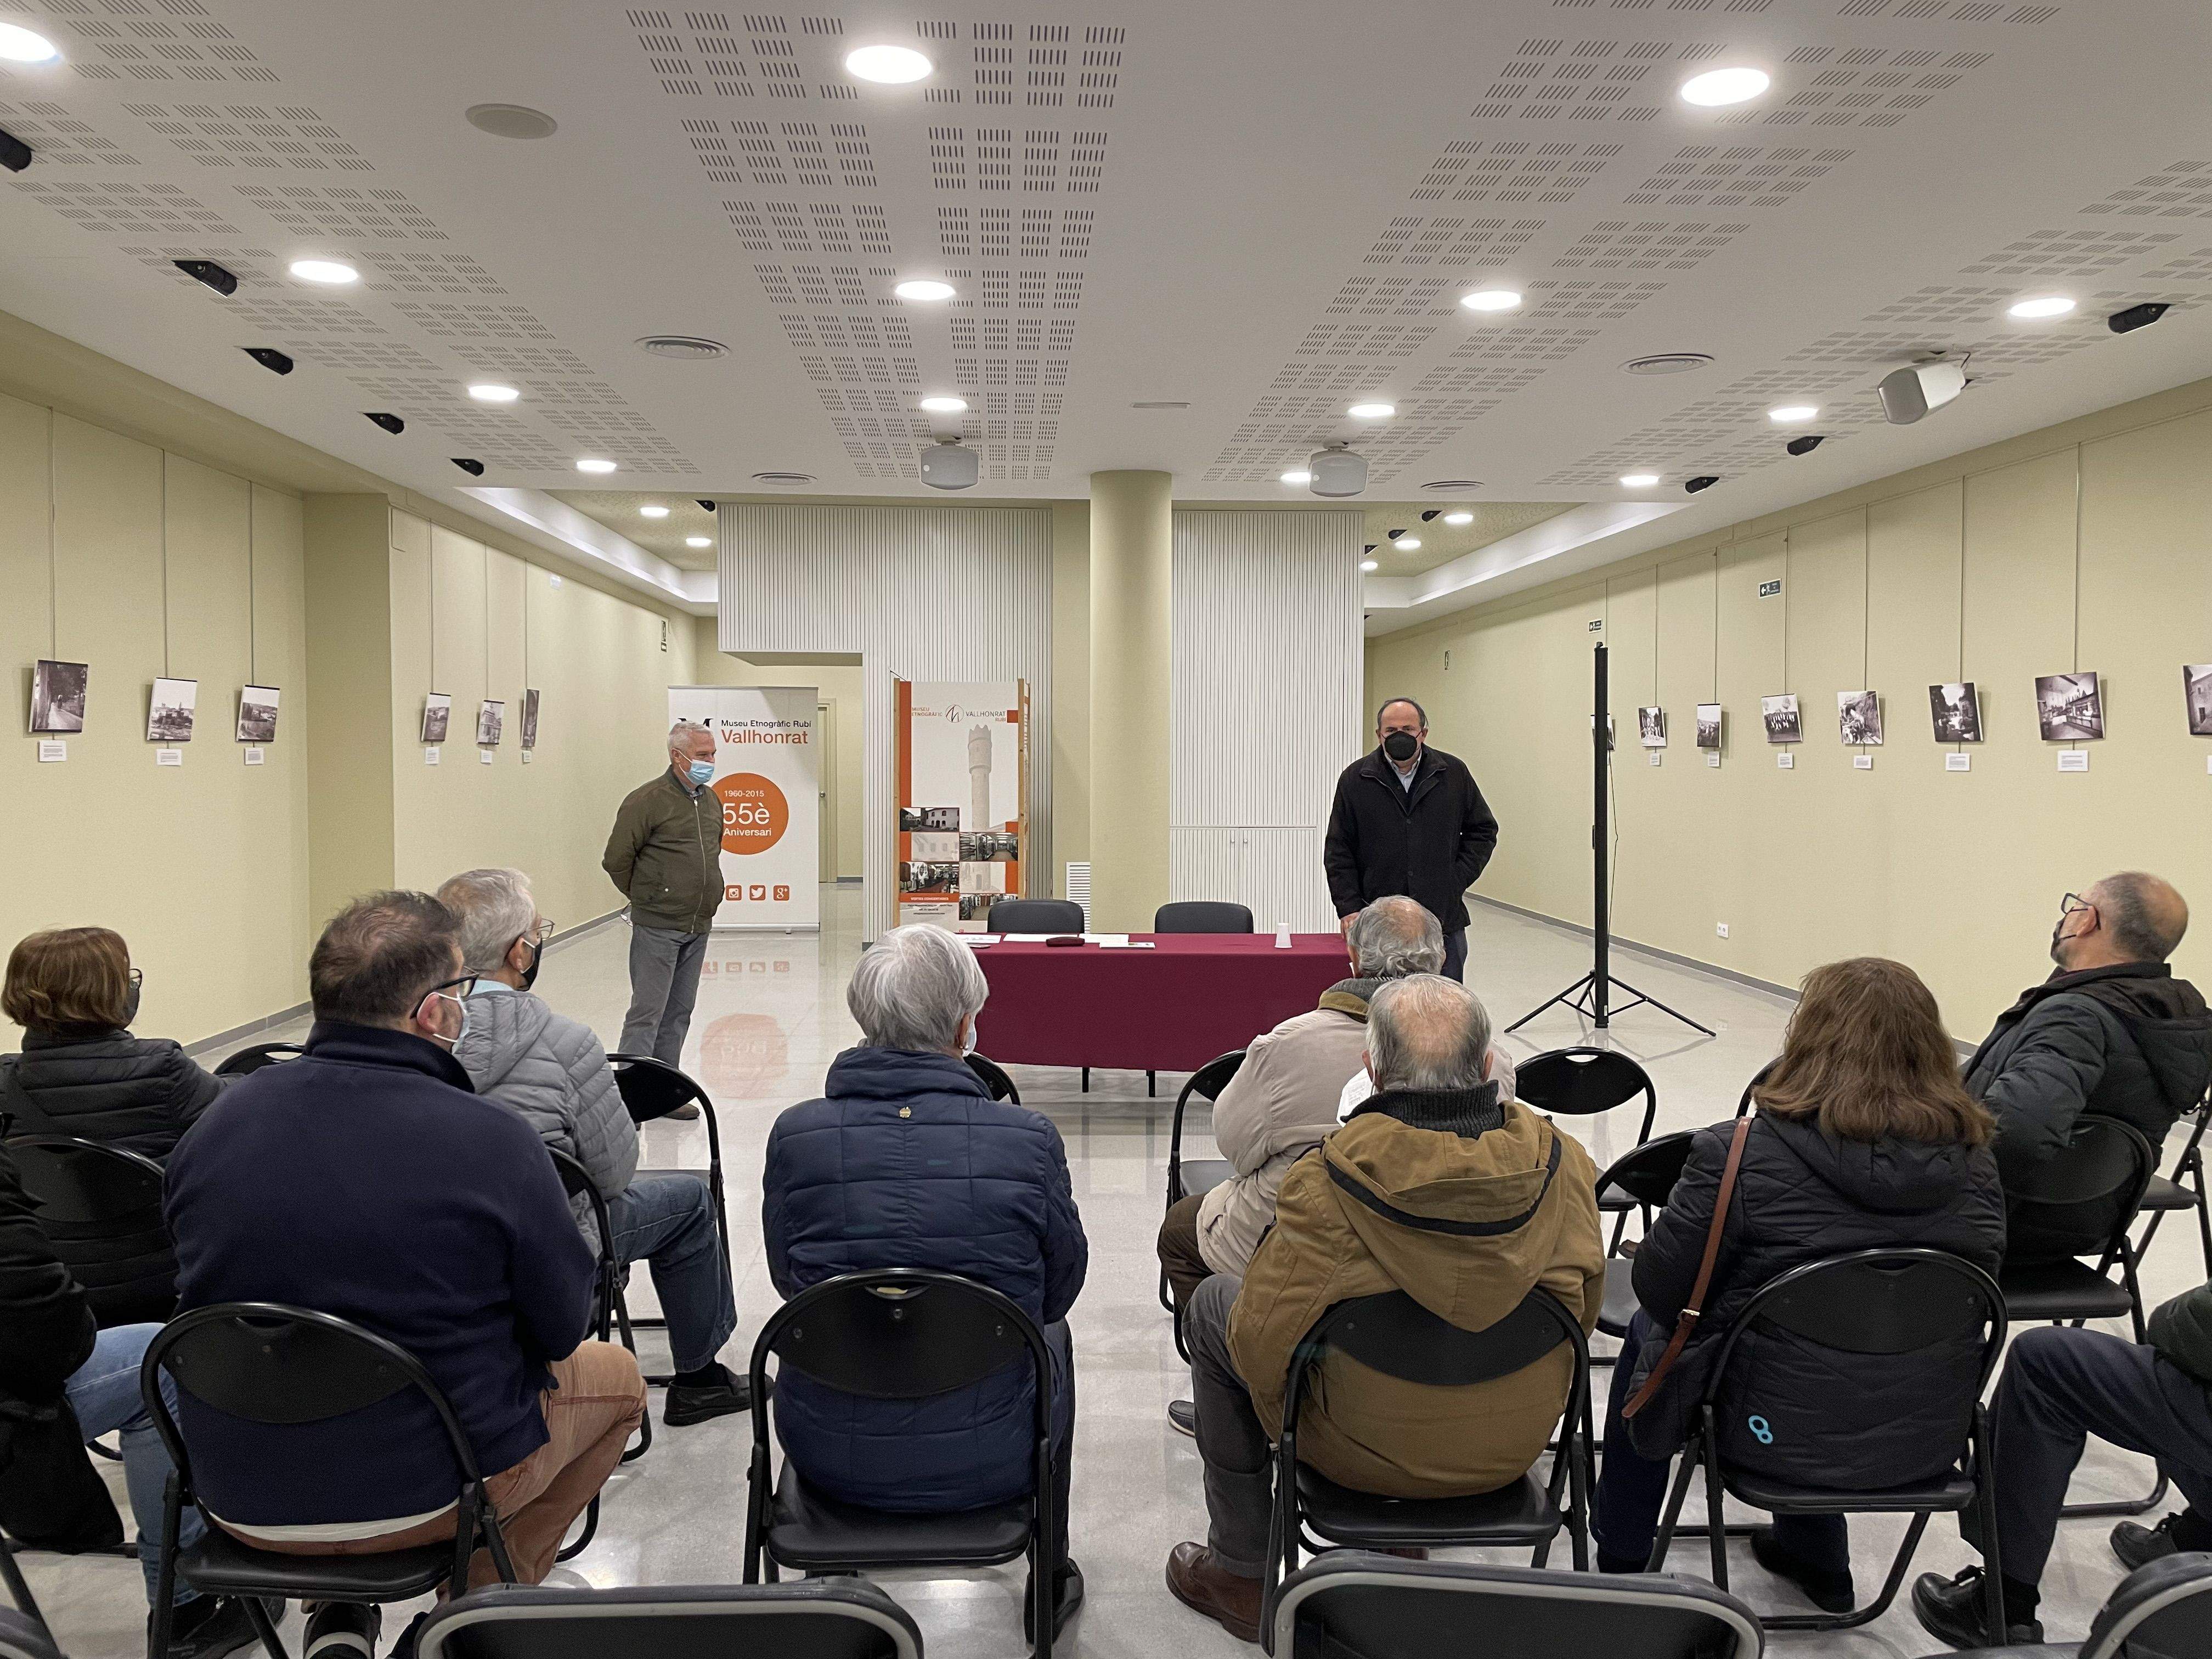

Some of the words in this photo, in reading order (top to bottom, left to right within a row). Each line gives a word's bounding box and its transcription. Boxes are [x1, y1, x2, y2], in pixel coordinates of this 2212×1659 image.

[751, 720, 791, 728] Etnogràfic
[721, 730, 808, 743] Vallhonrat
[723, 802, 770, 825] 55è
[723, 827, 772, 836] Aniversari
